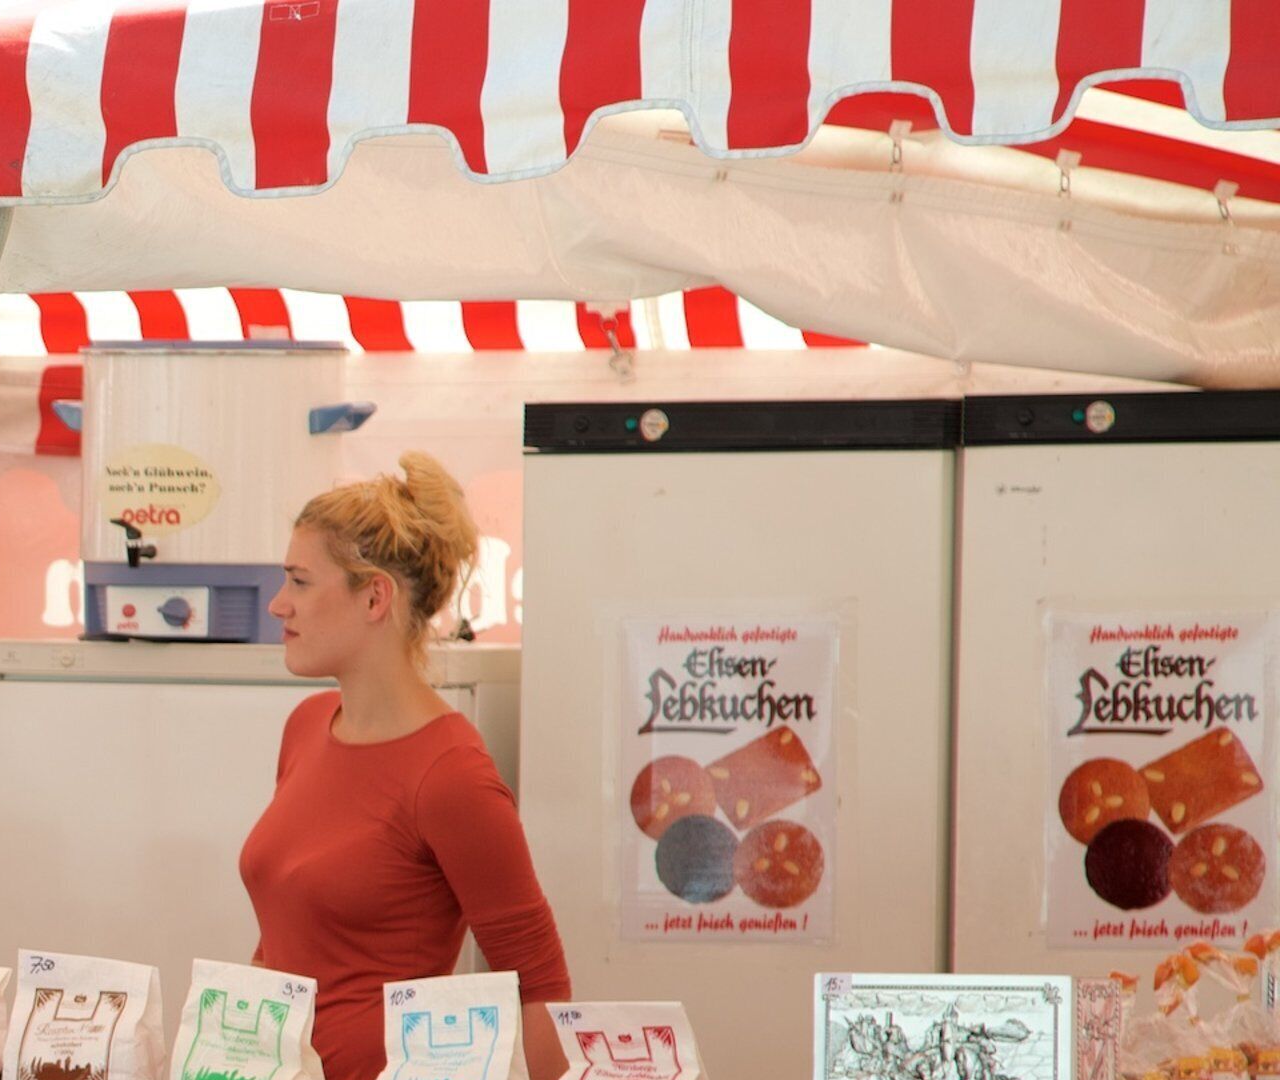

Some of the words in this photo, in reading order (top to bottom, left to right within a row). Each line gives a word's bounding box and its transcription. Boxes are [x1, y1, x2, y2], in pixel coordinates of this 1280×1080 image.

[149, 483, 206, 494] Punsch?
[658, 624, 737, 645] Handwerklich
[742, 626, 798, 643] gefertigte
[1090, 624, 1175, 644] Handwerklich
[1179, 624, 1239, 643] gefertigte
[682, 646, 777, 678] Elisen-
[1116, 645, 1216, 679] Elisen-
[638, 668, 817, 735] Lebkuchen
[1067, 668, 1258, 737] Lebkuchen
[663, 912, 692, 933] jetzt
[696, 911, 734, 933] frisch
[739, 911, 797, 934] genießen
[1093, 919, 1124, 940] jetzt
[1130, 918, 1168, 940] frisch
[1174, 918, 1236, 941] genießen
